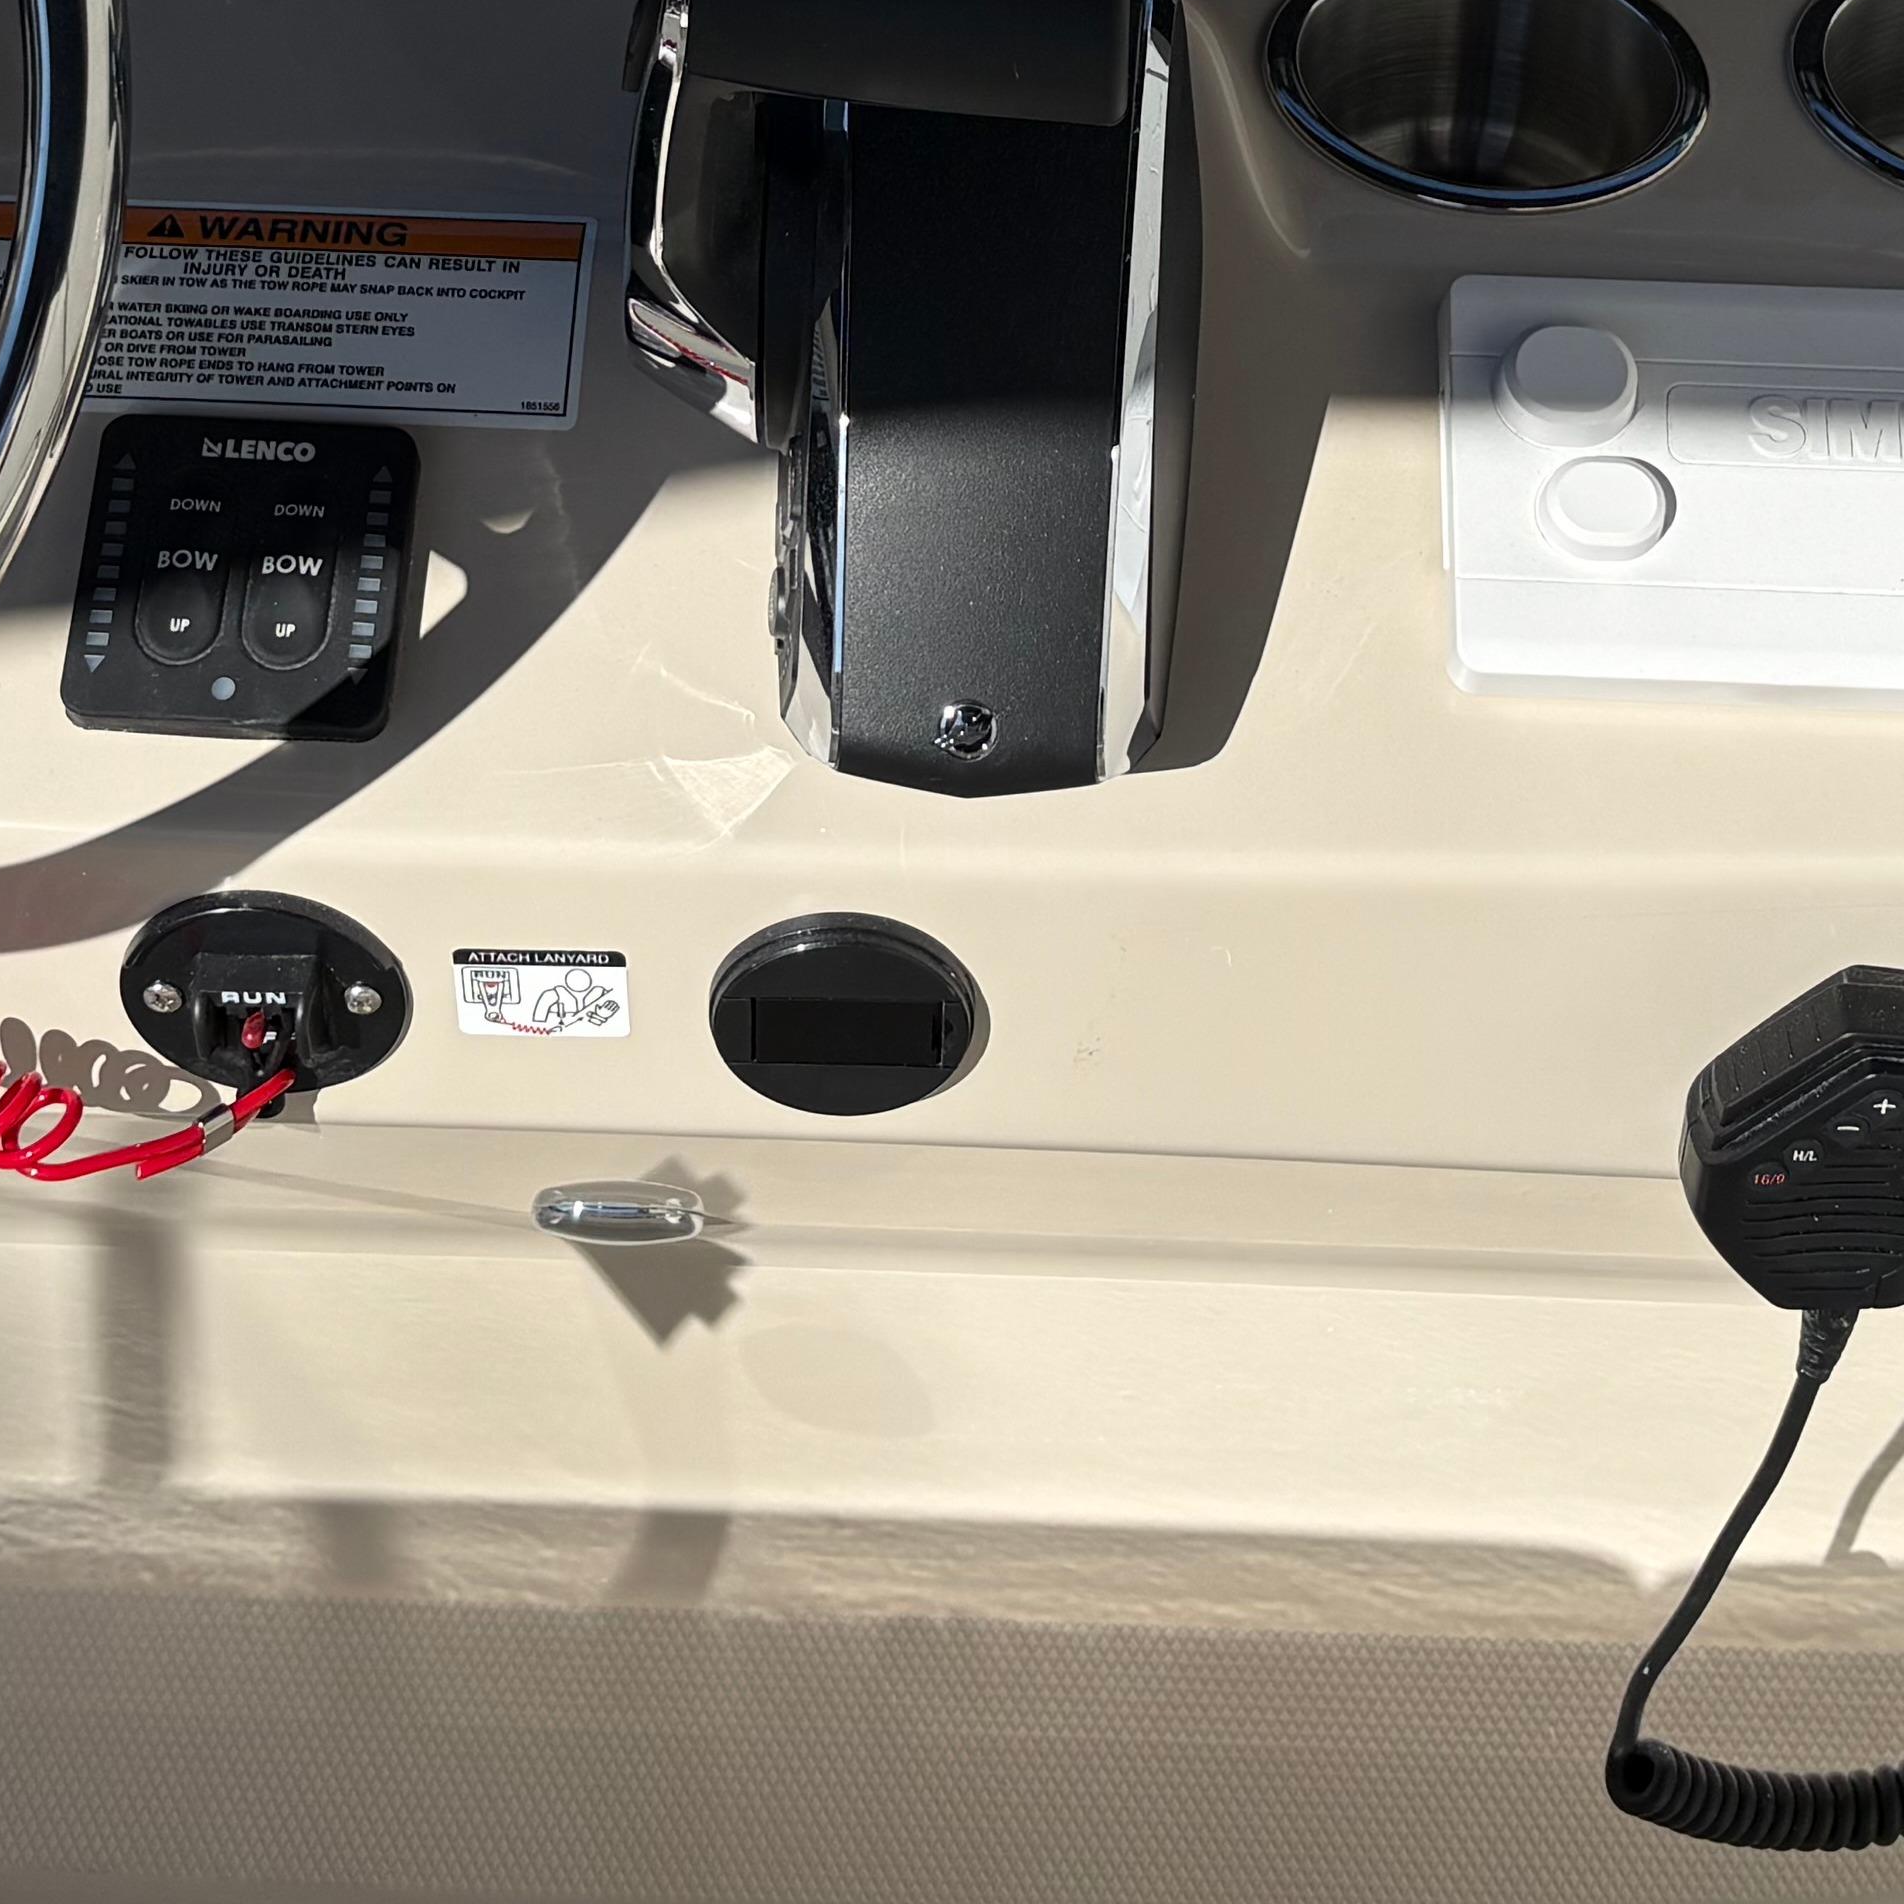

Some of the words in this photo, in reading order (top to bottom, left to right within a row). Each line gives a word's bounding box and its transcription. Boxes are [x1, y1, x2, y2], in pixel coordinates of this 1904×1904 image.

[199, 215, 408, 247] WARNING
[124, 245, 199, 261] FOLLOW
[205, 248, 263, 263] THESE
[269, 251, 377, 268] GUIDELINES
[384, 255, 422, 270] CAN
[428, 257, 497, 273] RESULT
[502, 260, 521, 274] IN
[183, 261, 248, 277] INJURY
[254, 264, 281, 279] OR
[287, 265, 347, 281] DEATH
[121, 274, 160, 286] SKIER
[161, 276, 176, 287] IN
[179, 276, 208, 288] TOW
[209, 277, 228, 289] AS
[231, 278, 257, 290] THE
[259, 279, 290, 291] TOW
[291, 280, 328, 293] ROPE
[329, 282, 358, 294] MAY
[359, 283, 395, 295] SNAP
[397, 285, 434, 297] BACK
[436, 287, 467, 298] INTO
[468, 288, 526, 301] COCKPIT
[226, 440, 316, 463] LENCO
[169, 498, 222, 513] DOWN
[274, 504, 325, 519] DOWN
[157, 550, 218, 572] BOW
[261, 555, 323, 577] BOW
[169, 617, 190, 634] UP
[276, 622, 296, 639] UP
[468, 951, 530, 963] ATTACH
[534, 952, 610, 965] LANYARD
[221, 991, 286, 1005] RUN
[1792, 1150, 1818, 1162] H/L
